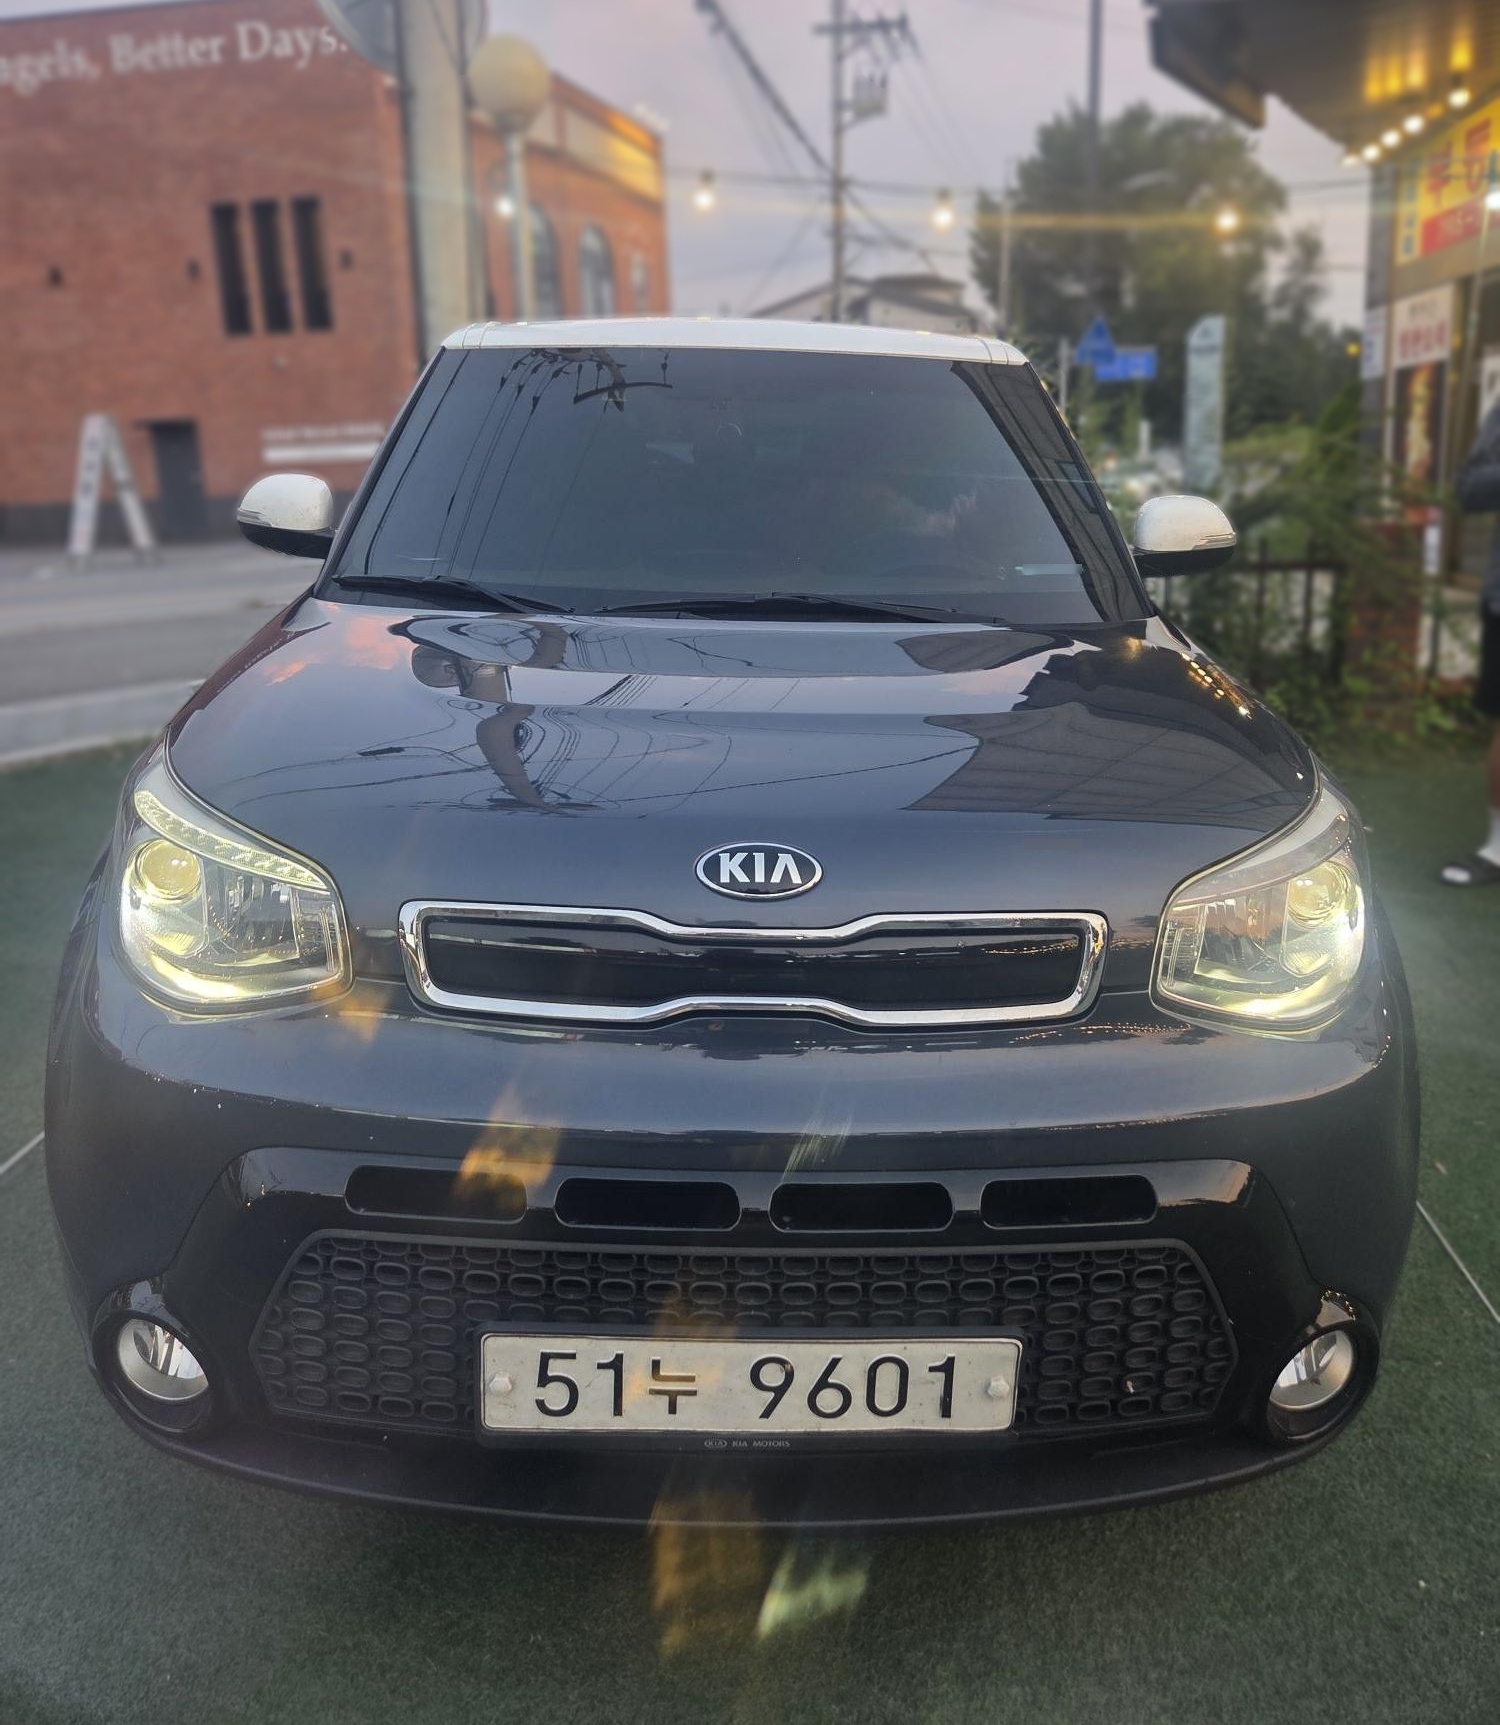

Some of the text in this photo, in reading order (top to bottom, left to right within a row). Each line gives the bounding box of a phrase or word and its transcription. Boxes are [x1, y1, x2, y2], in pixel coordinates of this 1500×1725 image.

[108, 32, 225, 75] Better
[235, 20, 348, 69] Days.
[718, 852, 803, 884] KIA
[535, 1350, 956, 1418] 51누 9601
